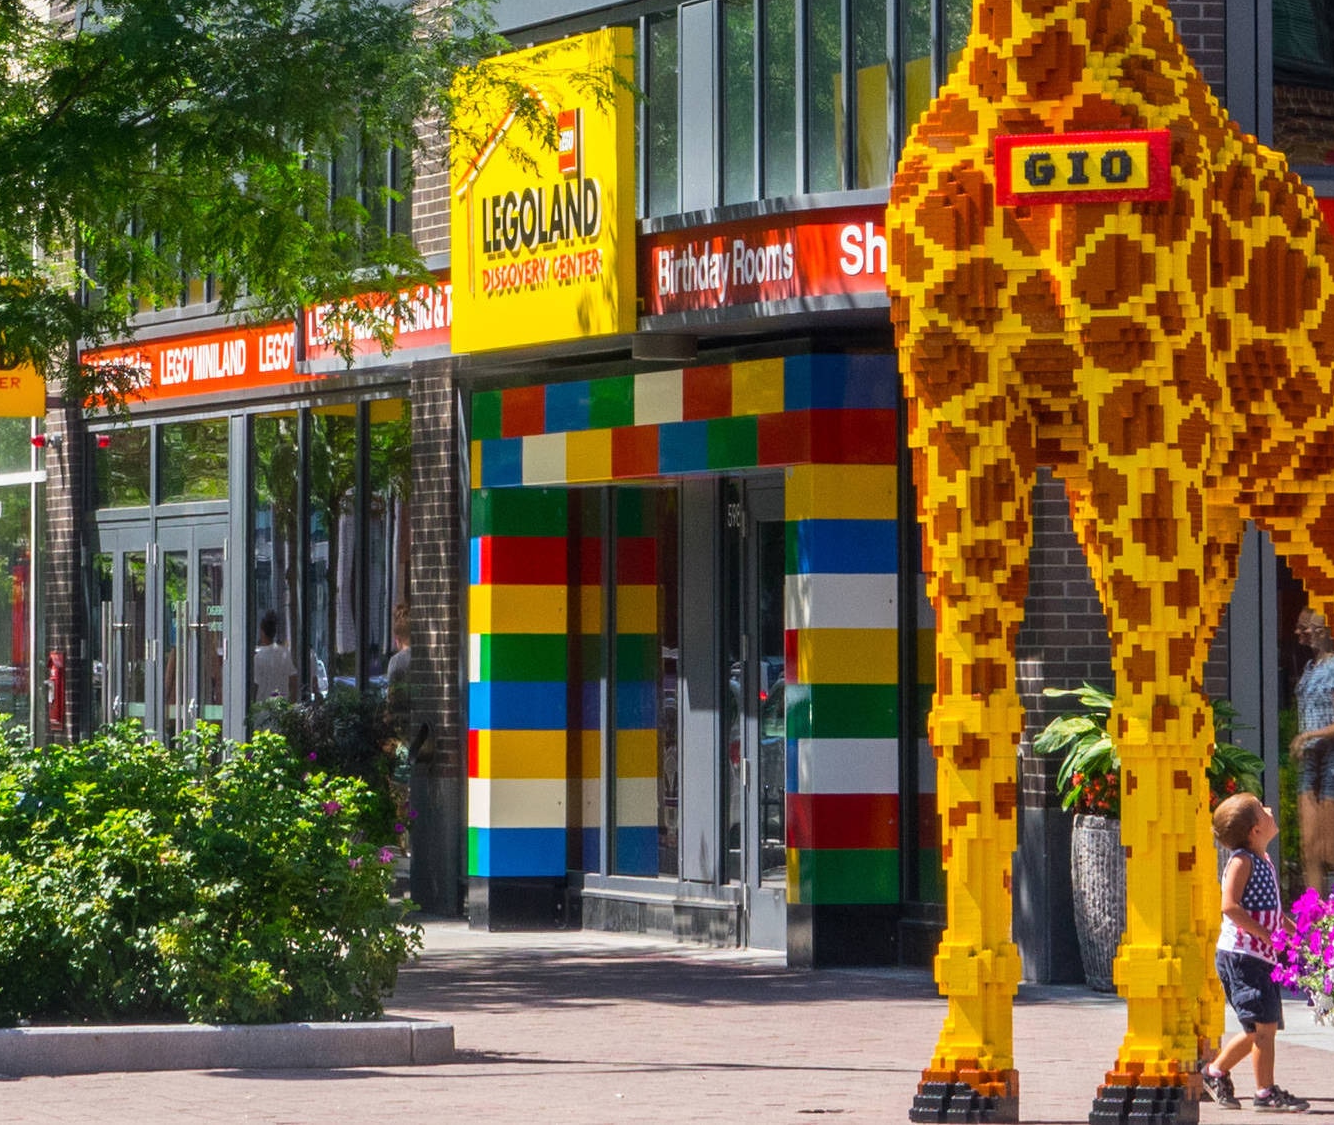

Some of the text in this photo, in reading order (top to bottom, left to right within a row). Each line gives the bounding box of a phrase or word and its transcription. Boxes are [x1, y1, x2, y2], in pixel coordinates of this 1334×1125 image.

[1024, 149, 1132, 186] GIO
[482, 248, 601, 292] DISCOVERY CENTER
[658, 239, 794, 304] Birthday Rooms
